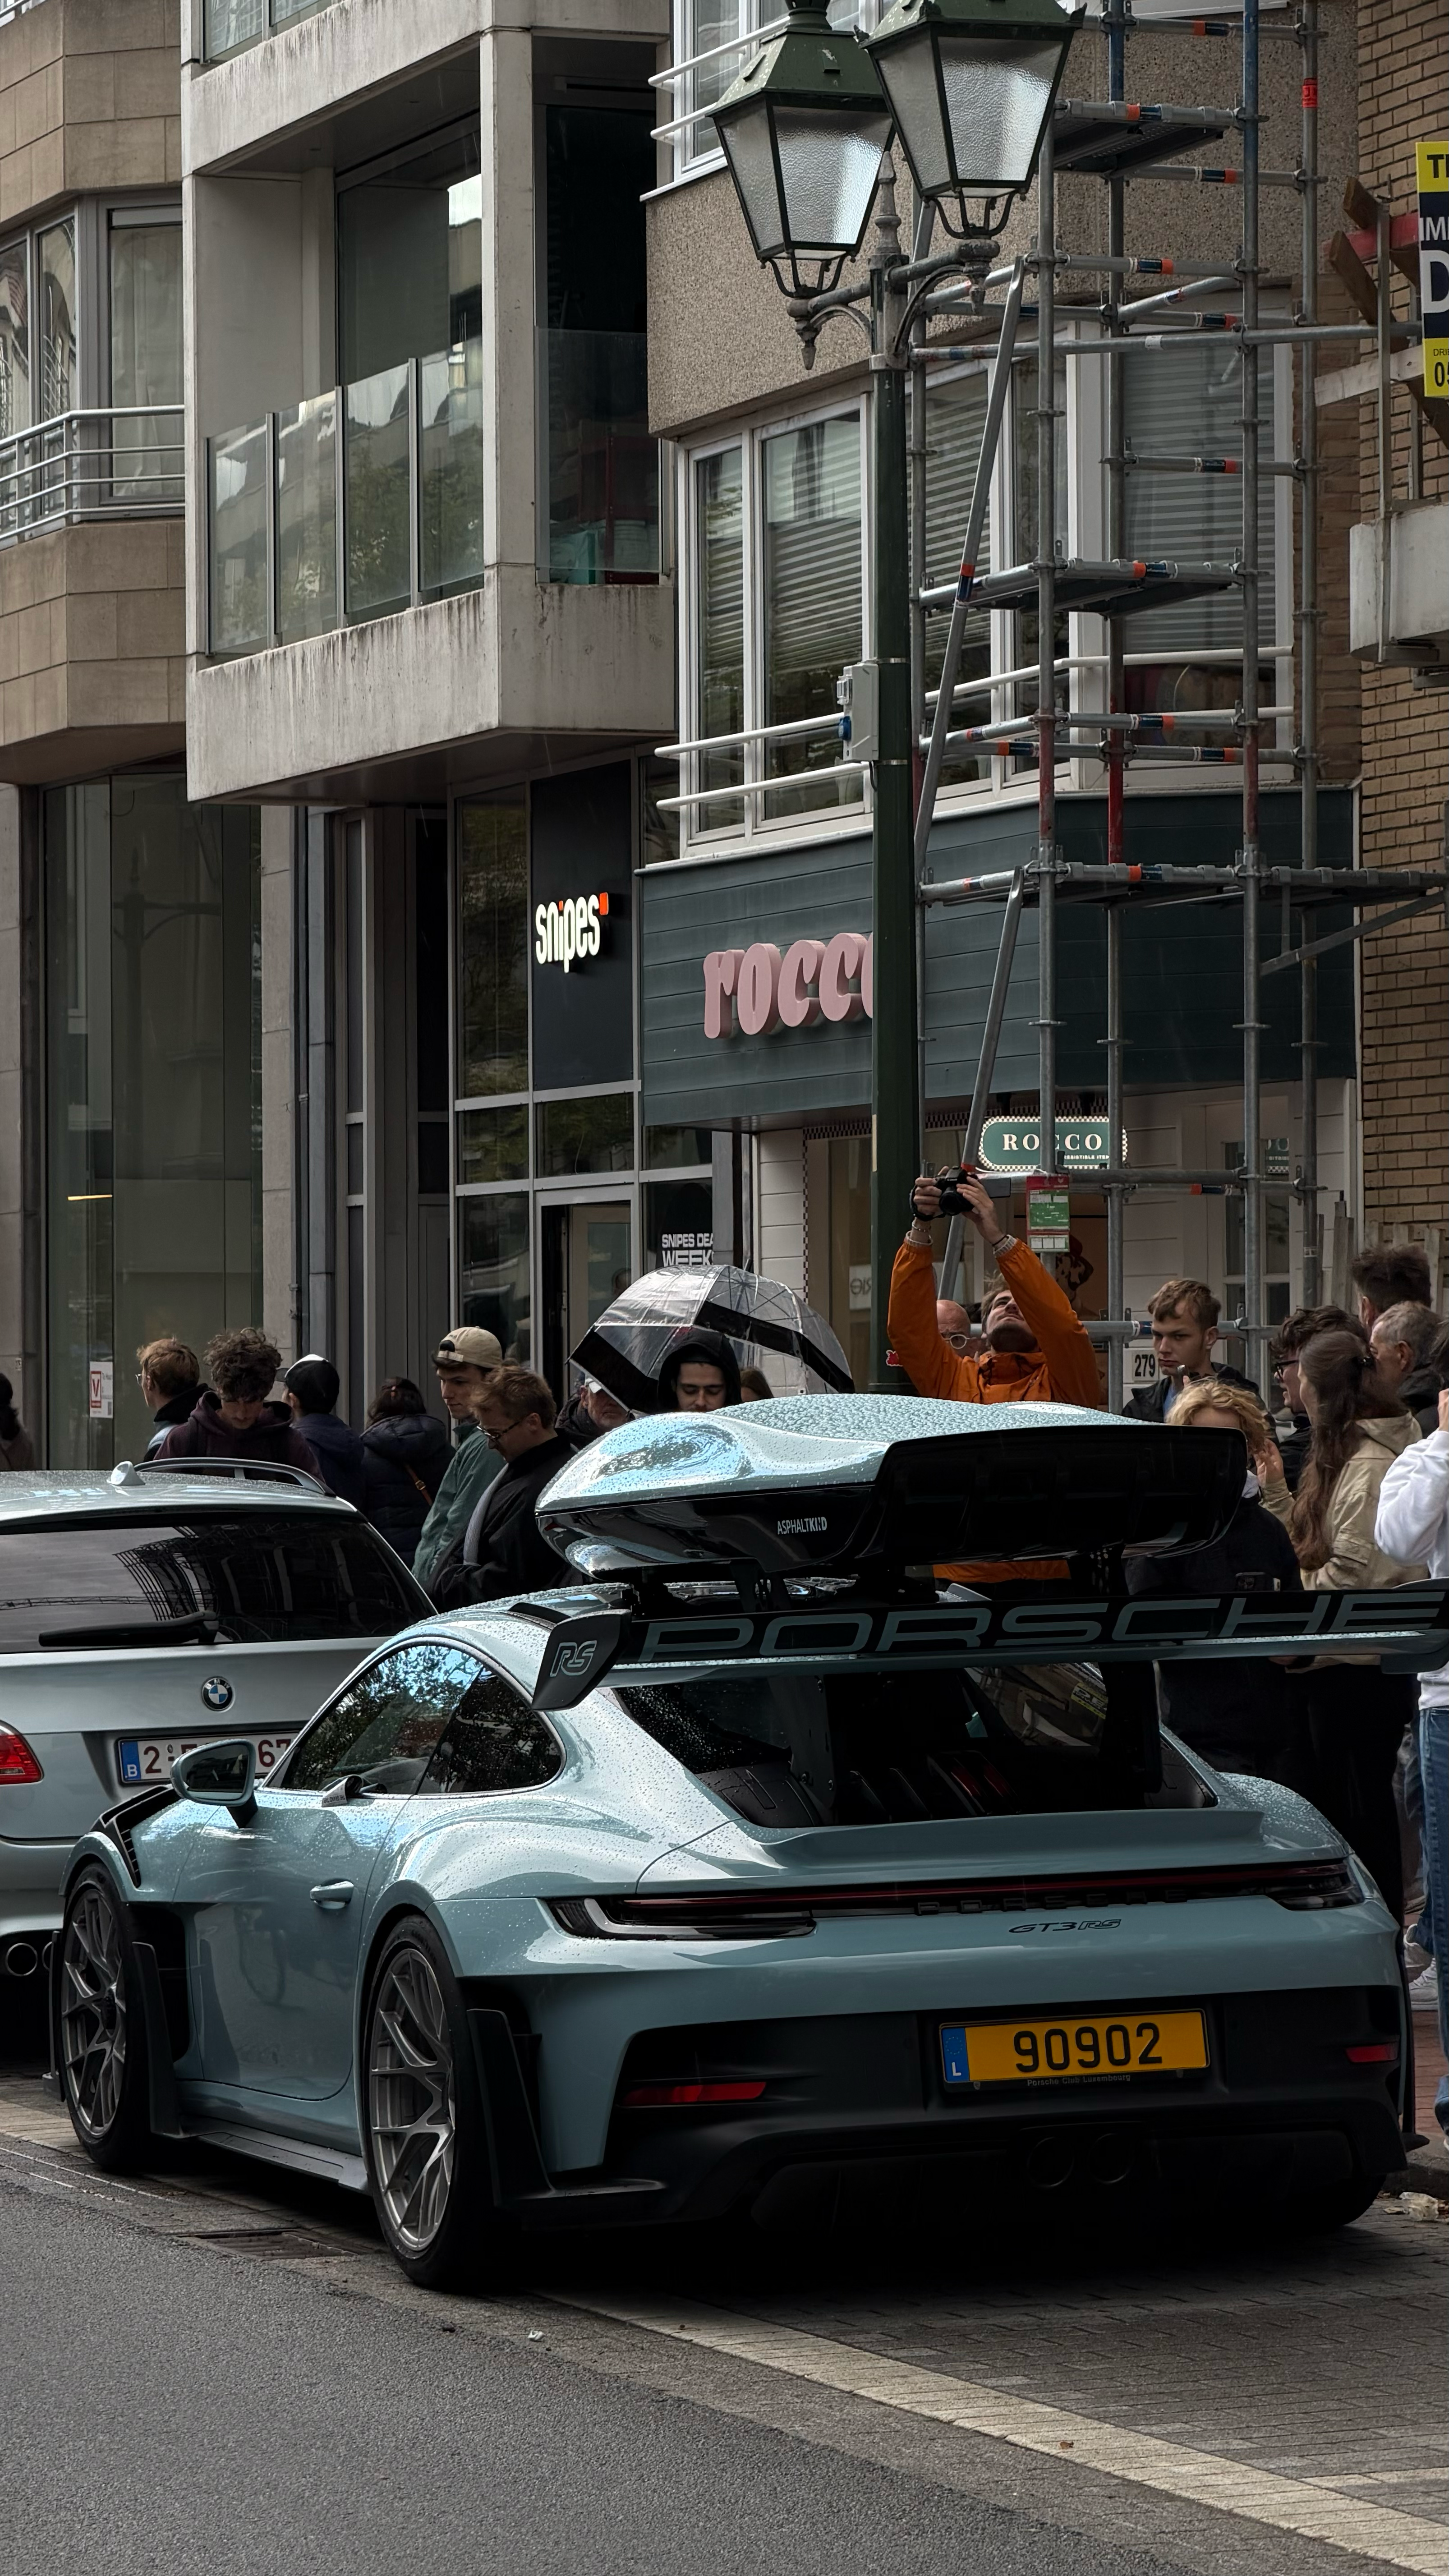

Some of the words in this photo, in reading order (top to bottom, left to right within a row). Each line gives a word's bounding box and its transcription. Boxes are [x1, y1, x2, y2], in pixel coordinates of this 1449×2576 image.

[1427, 154, 1449, 179] T
[1420, 216, 1449, 241] IM
[1435, 362, 1449, 387] 0
[535, 894, 600, 973] snipes
[662, 1233, 695, 1248] SNIPES
[662, 1250, 714, 1267] WEEK
[1134, 1354, 1155, 1377] 279
[777, 1517, 828, 1535] ASPHALTKIND
[639, 1592, 1445, 1661] PORSCHE
[550, 1640, 597, 1677] RS
[127, 1764, 138, 1777] B
[1013, 2022, 1163, 2073] 90902
[952, 2062, 961, 2077] L
[1027, 2077, 1059, 2087] Porsche
[1062, 2075, 1080, 2084] Club
[1082, 2074, 1131, 2083] Luxembourg
